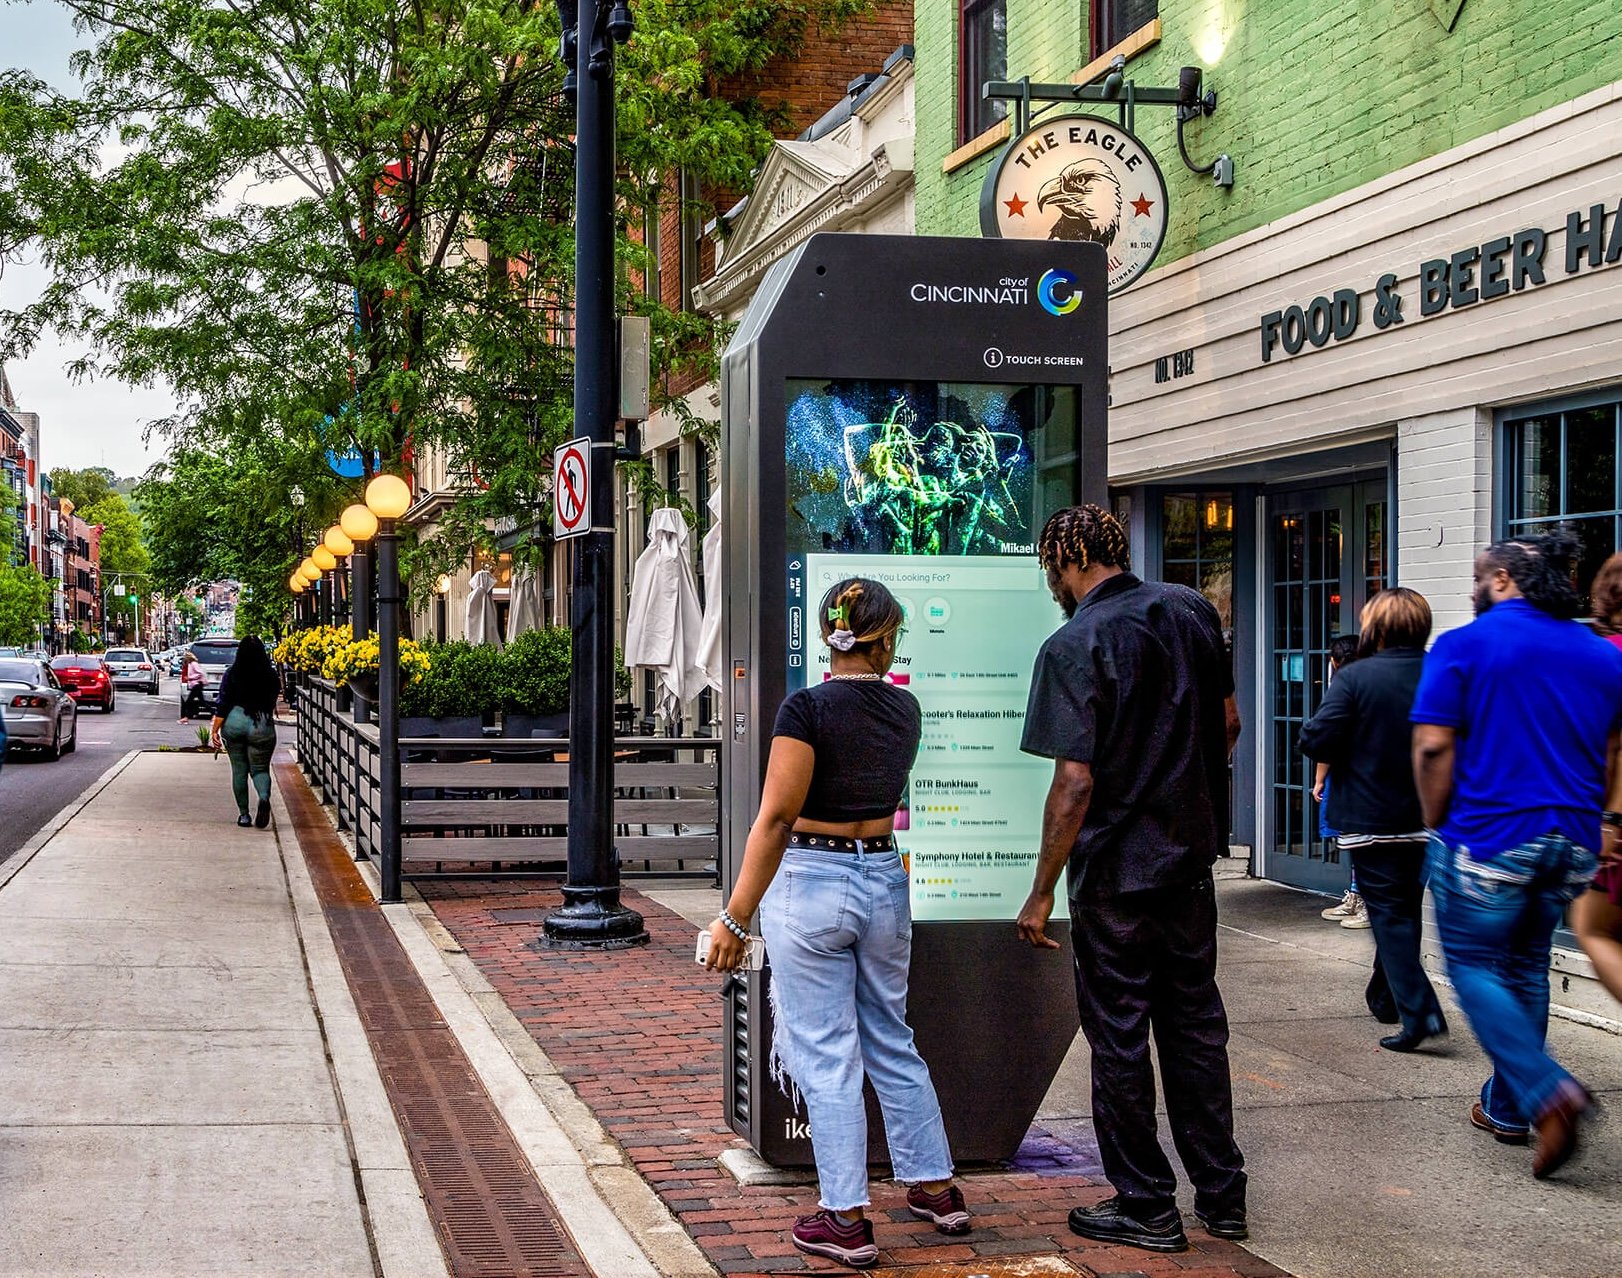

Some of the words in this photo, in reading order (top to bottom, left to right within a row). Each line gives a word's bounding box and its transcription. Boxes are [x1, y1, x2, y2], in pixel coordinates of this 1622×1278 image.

[1014, 131, 1060, 169] THE
[1068, 127, 1143, 173] EAGLE
[1140, 241, 1152, 249] 1342
[999, 276, 1018, 288] city
[1018, 277, 1029, 287] of
[910, 283, 1028, 305] CINCINNATI
[1261, 288, 1359, 362] FOOD
[1373, 273, 1405, 329] &
[1420, 228, 1546, 316] BEER
[1005, 355, 1041, 365] TOUCH
[1044, 356, 1084, 366] SCREEN
[1001, 542, 1035, 554] Mikael
[879, 573, 895, 582] You
[896, 573, 930, 584] Looking
[932, 573, 951, 582] For?
[893, 655, 911, 666] Stay
[920, 709, 954, 719] cooter's
[956, 709, 1000, 719] Relaxation
[915, 779, 933, 789] OTR
[935, 778, 979, 789] BunkHaus
[915, 851, 960, 863] Symphony
[961, 851, 985, 860] Hotel
[986, 851, 993, 860] &
